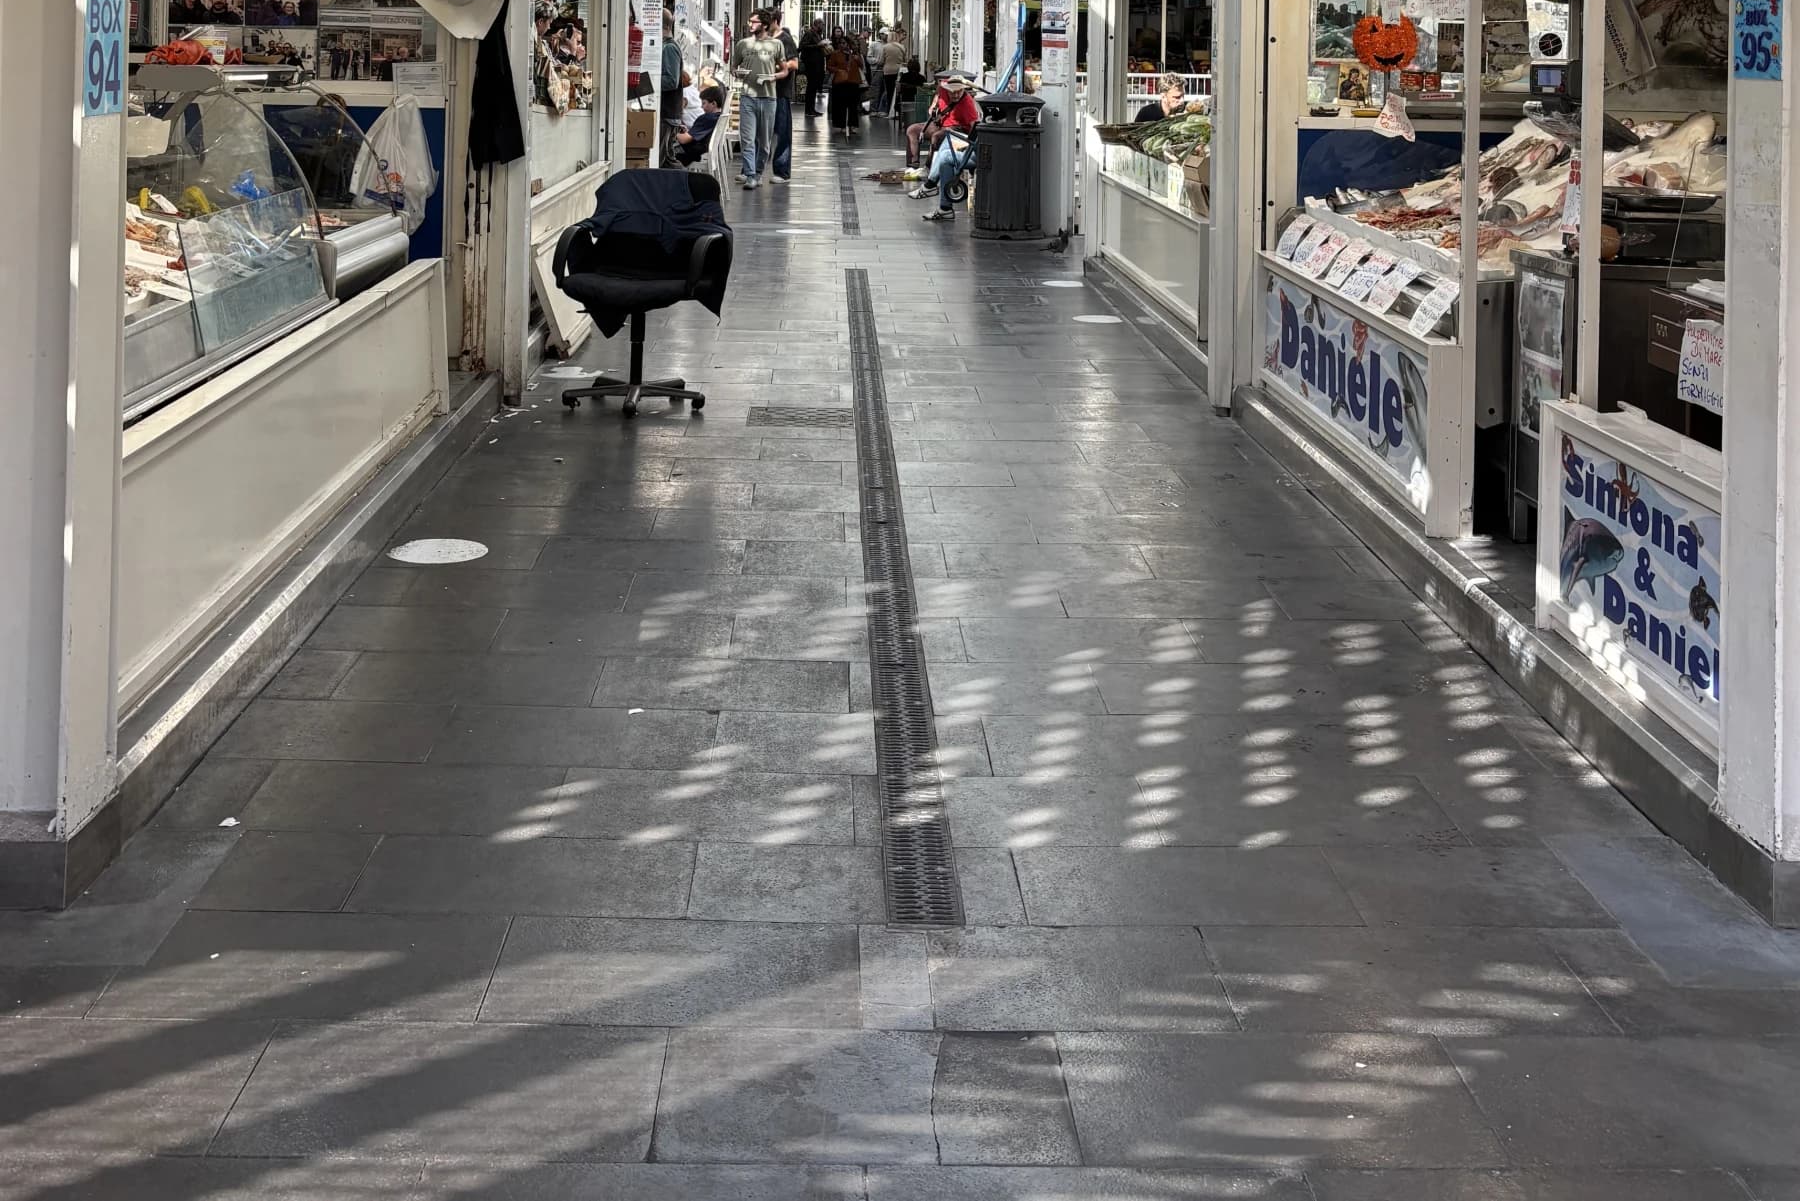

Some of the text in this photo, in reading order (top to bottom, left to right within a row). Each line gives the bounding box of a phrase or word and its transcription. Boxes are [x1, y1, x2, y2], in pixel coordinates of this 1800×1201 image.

[90, 0, 121, 34] BOX
[1745, 9, 1768, 27] BOX
[88, 39, 120, 109] 94
[1742, 32, 1773, 73] 95
[1281, 303, 1403, 448] Daniele
[1565, 454, 1698, 570] Simona
[1633, 547, 1657, 601] &
[1603, 574, 1720, 701] Daniel
